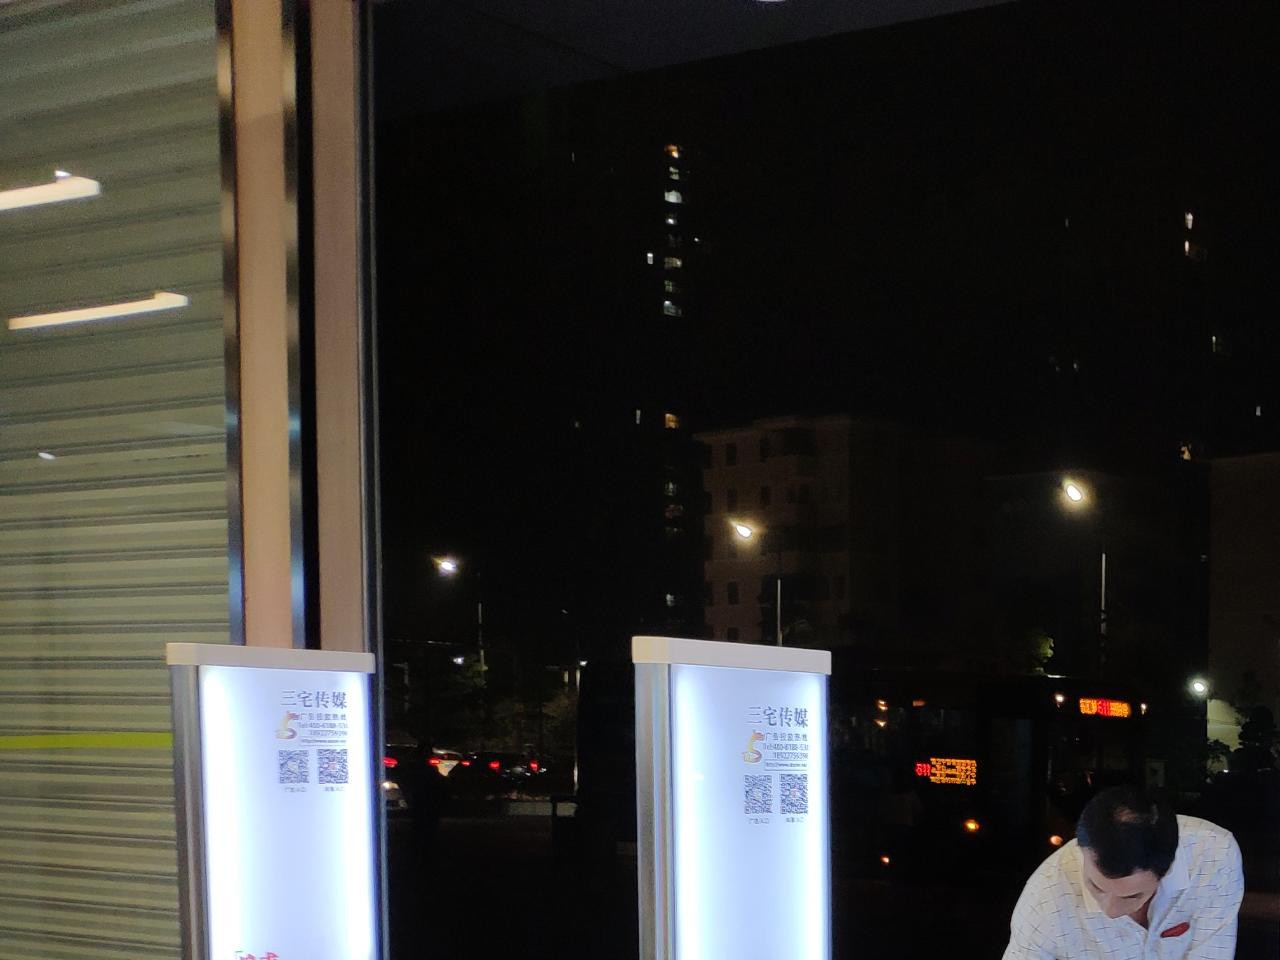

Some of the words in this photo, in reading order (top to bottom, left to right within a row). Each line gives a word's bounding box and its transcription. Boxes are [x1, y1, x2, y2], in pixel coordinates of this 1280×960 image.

[280, 690, 348, 709] 三宅传媒
[747, 706, 809, 728] 三宅传媒
